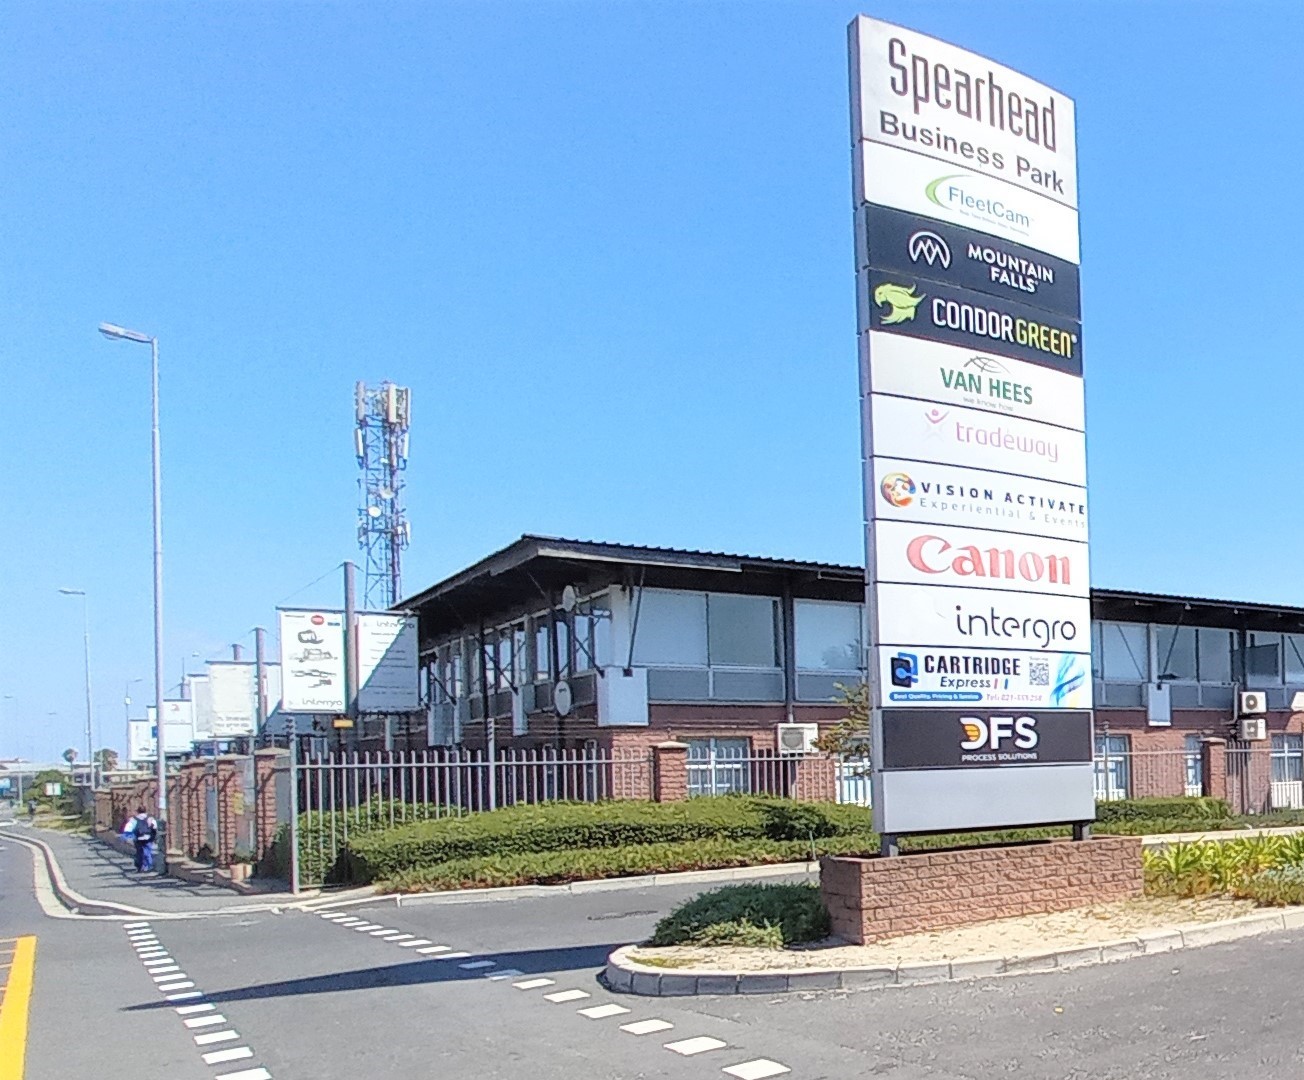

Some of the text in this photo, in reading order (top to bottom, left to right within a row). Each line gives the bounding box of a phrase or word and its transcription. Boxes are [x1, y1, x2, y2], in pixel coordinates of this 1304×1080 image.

[888, 37, 1057, 153] Spearhead
[880, 110, 1064, 195] Business Park
[949, 185, 1030, 227] FleetCam
[967, 243, 1054, 284] MOUNTAIN
[990, 267, 1036, 293] FALLS
[940, 367, 1033, 405] VAN HEES
[956, 422, 1059, 462] tradeway
[920, 498, 1085, 528] Experiential & Events
[921, 482, 1085, 515] VISION ACTIVATE
[906, 535, 1071, 585] Canon
[955, 605, 1076, 649] intergro
[924, 655, 1020, 676] CARTRIDGE
[940, 676, 991, 690] Express
[960, 716, 1039, 750] DFS
[961, 752, 1038, 762] PROCESS SOLUTIONS
